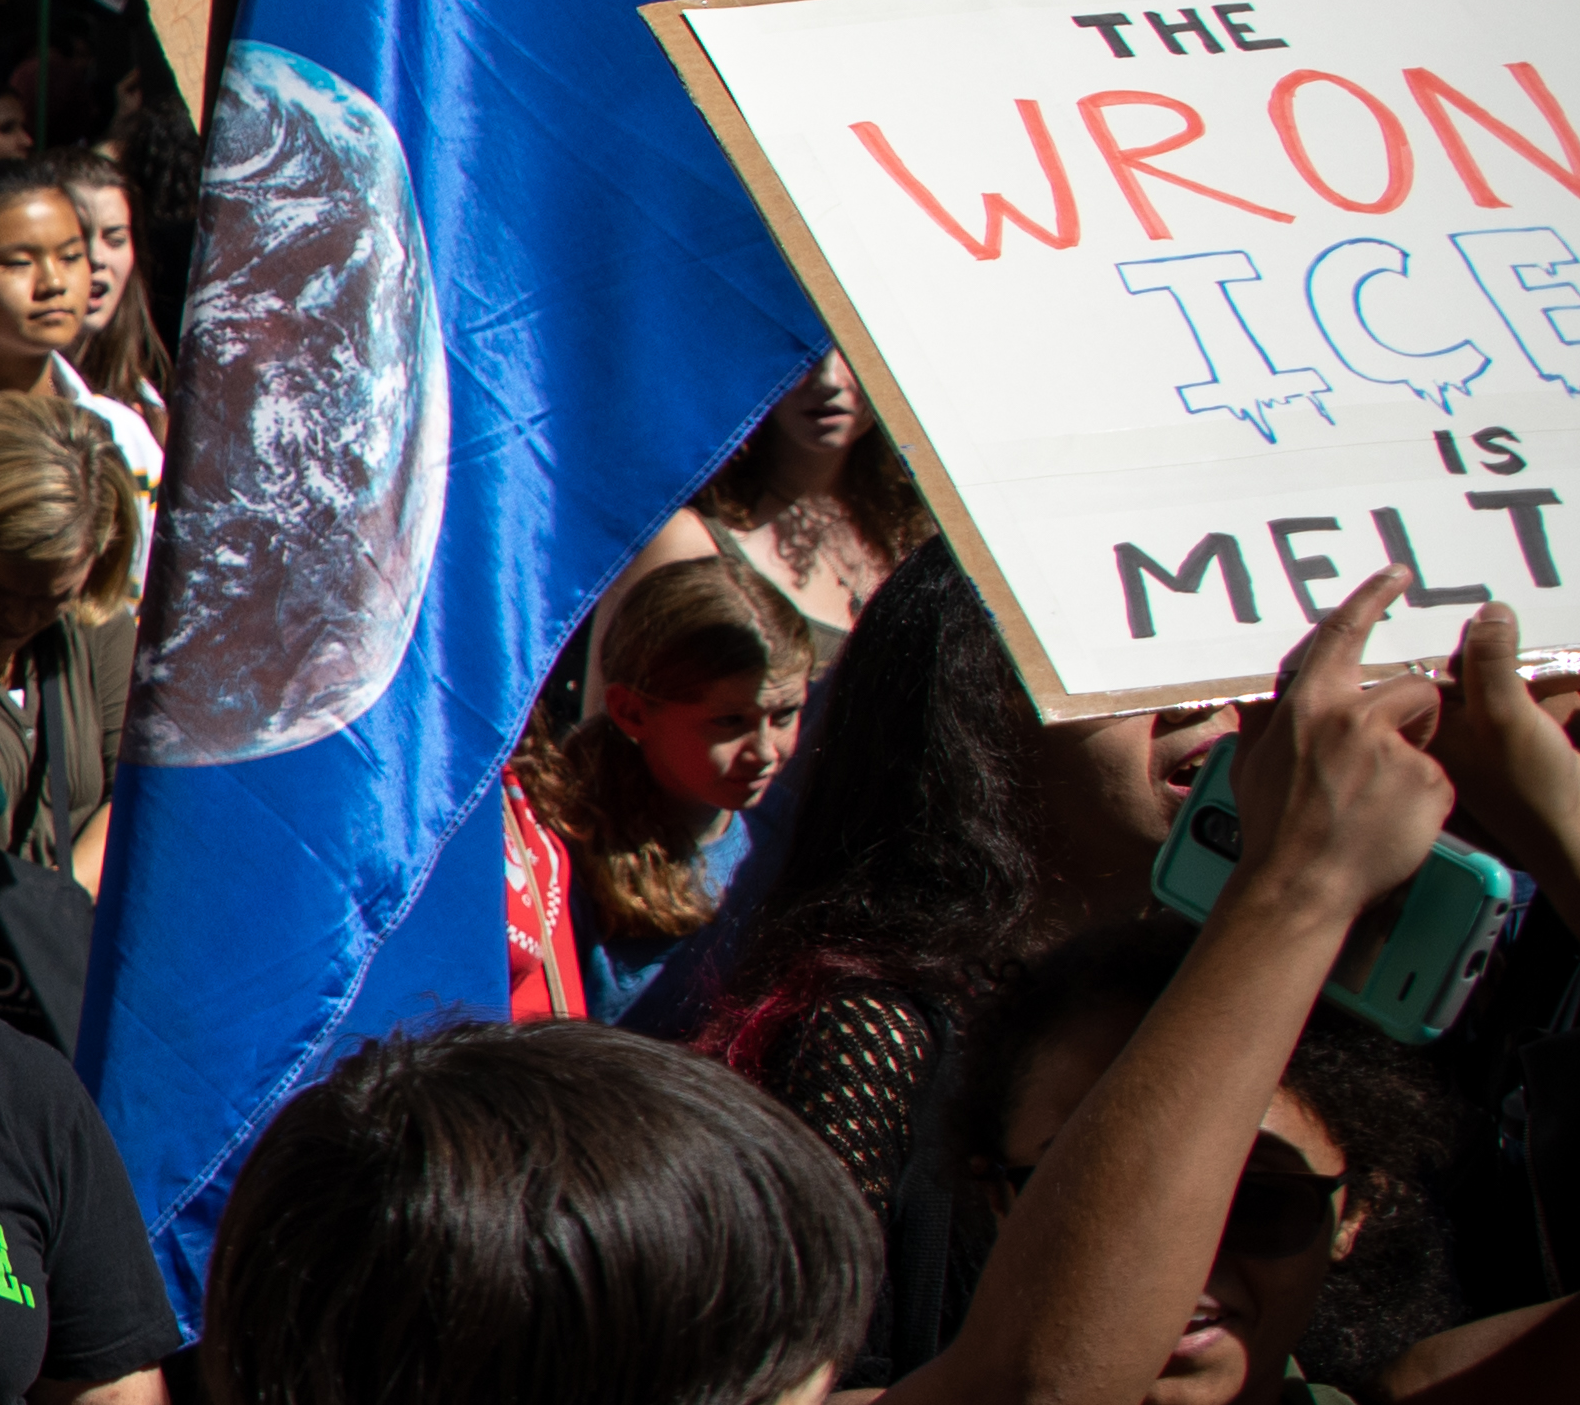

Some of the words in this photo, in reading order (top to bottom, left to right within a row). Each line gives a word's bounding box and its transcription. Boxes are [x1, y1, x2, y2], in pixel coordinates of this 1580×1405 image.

[1072, 2, 1290, 58] THE
[1115, 226, 1580, 445] ICE
[1433, 427, 1528, 476] IS
